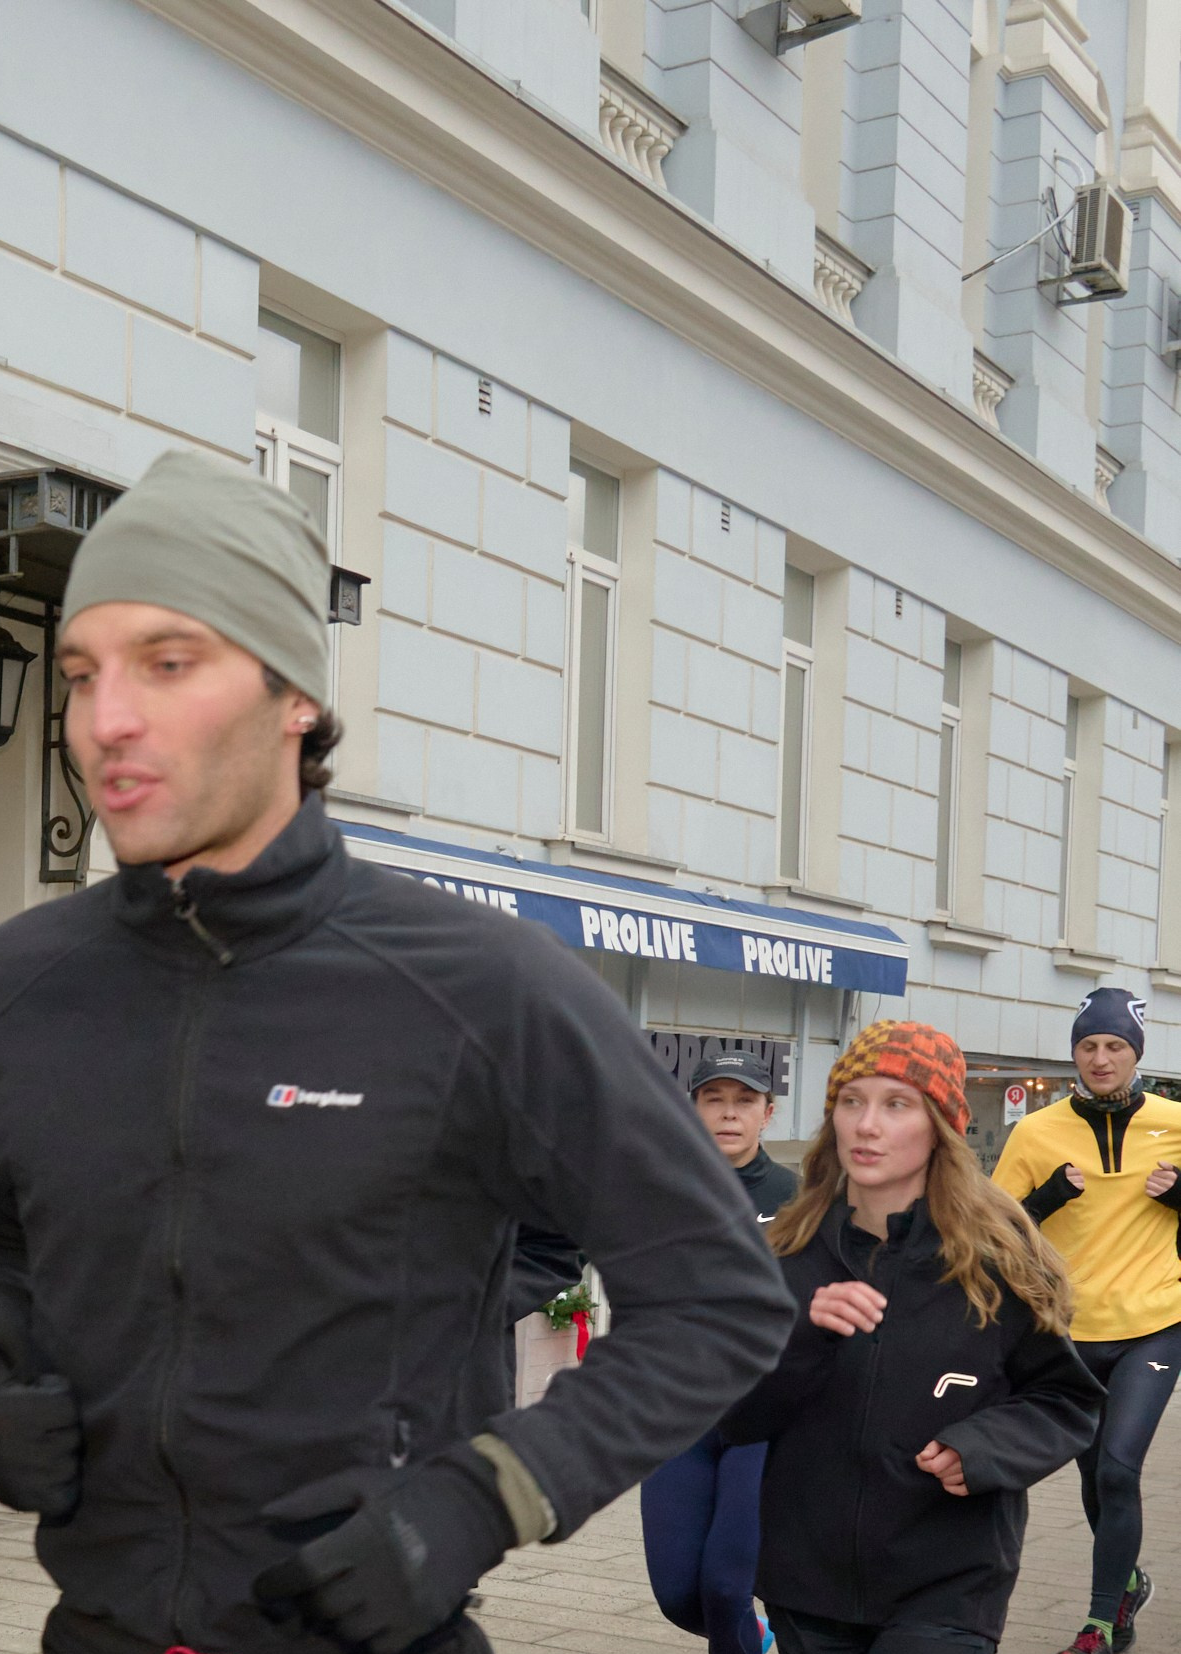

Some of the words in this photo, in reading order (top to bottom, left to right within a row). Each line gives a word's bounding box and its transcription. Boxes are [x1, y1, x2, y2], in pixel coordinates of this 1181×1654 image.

[580, 905, 697, 962] PROLIVE
[741, 935, 833, 984] PROLIVE
[656, 1031, 791, 1096] PRVE
